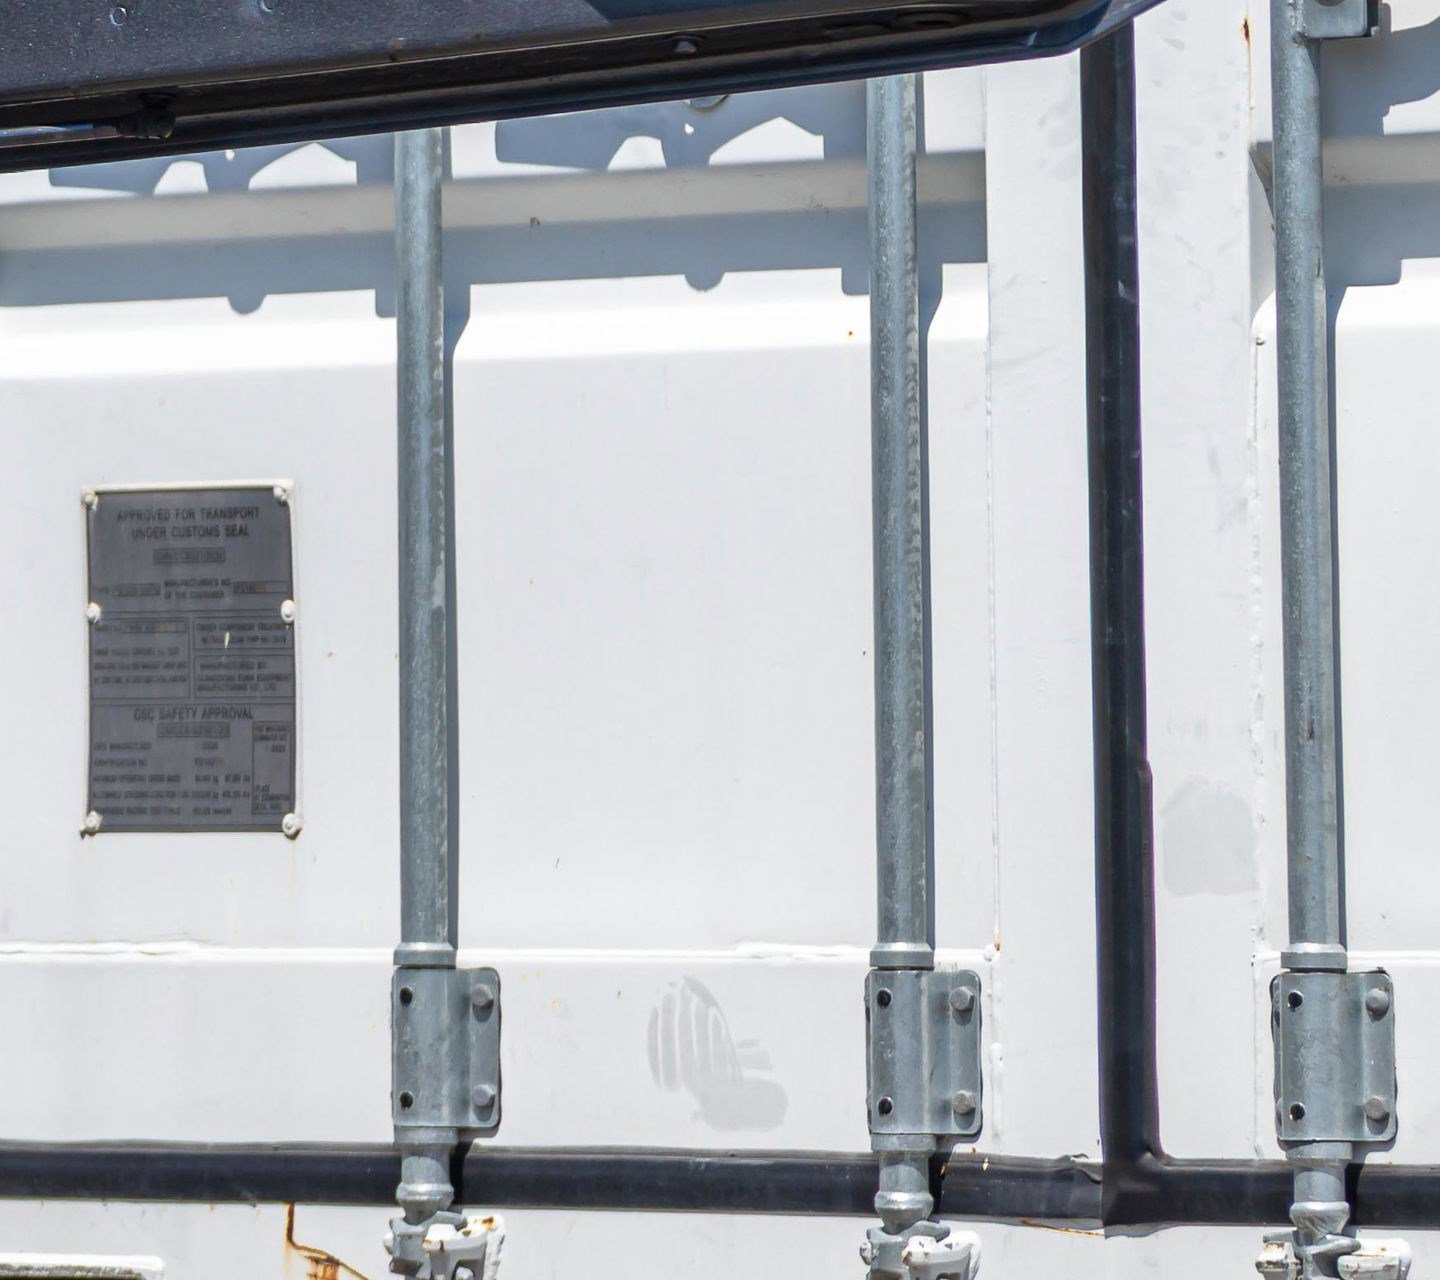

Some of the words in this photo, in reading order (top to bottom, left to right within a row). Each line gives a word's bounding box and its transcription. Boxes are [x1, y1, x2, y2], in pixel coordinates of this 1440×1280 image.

[117, 508, 171, 522] APPROVED
[175, 507, 195, 520] FOR
[201, 506, 260, 520] TRANSPORT
[132, 526, 166, 540] UNDER
[171, 525, 220, 538] CUSTOMS
[225, 524, 250, 537] SEAL
[134, 708, 154, 721] CSC
[159, 707, 198, 720] SAFETY
[201, 706, 254, 720] APPROVAL
